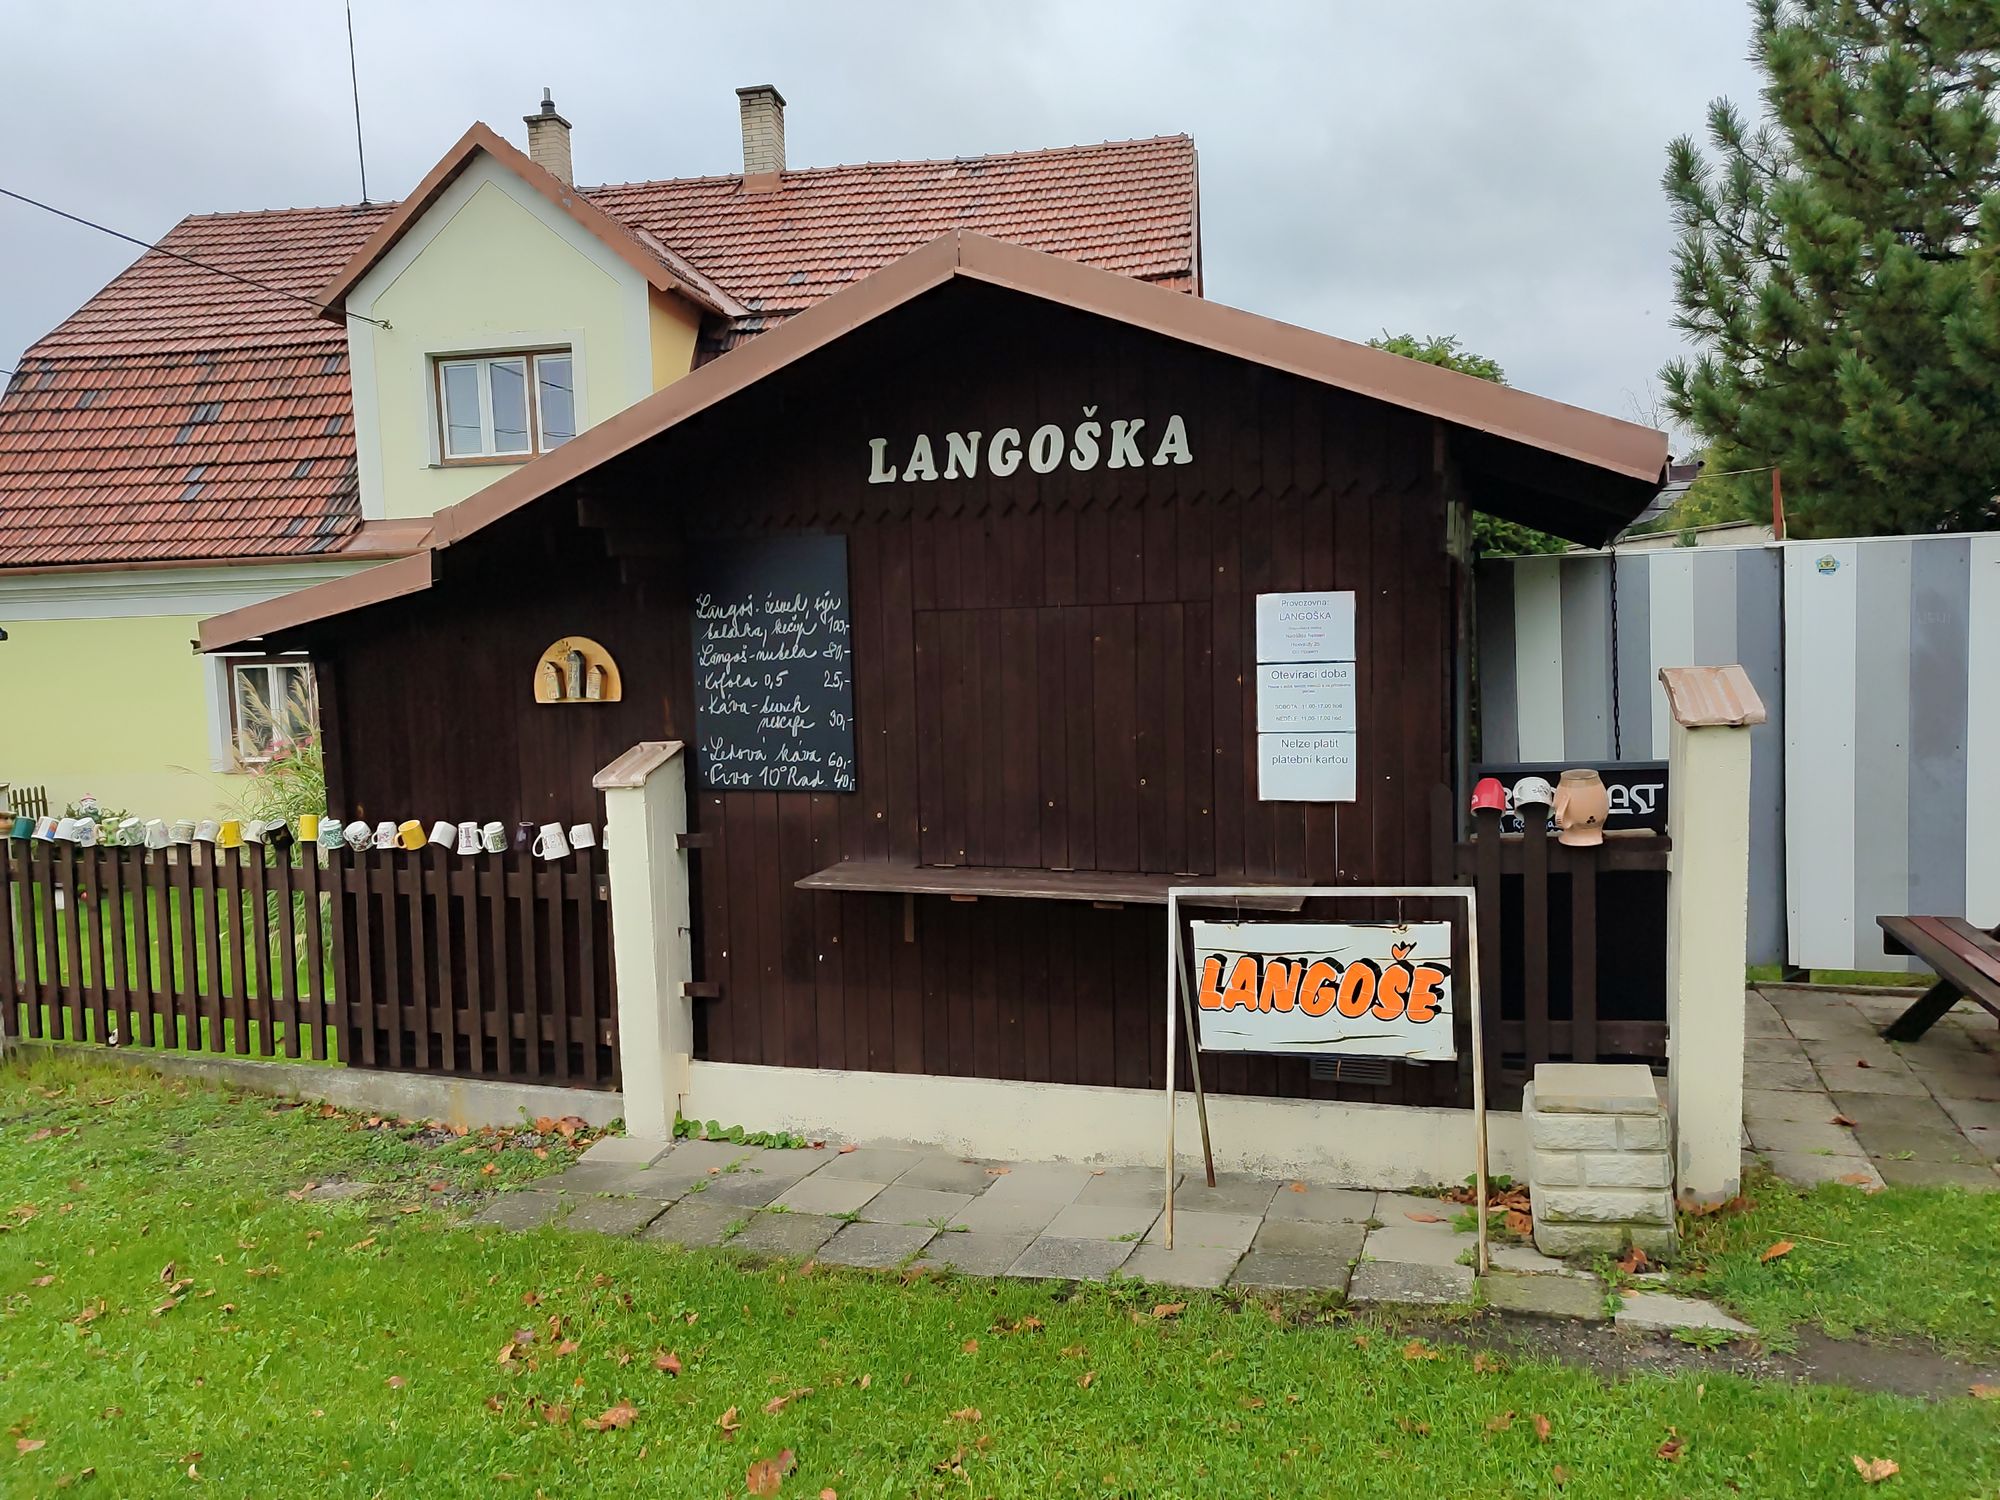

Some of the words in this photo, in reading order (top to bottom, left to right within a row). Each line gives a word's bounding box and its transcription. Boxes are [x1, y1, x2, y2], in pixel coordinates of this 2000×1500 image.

[867, 405, 1194, 485] LANGOŠKA
[813, 590, 842, 625] sýr
[1281, 599, 1329, 607] Provozovna:
[827, 615, 850, 636] 100,-
[1279, 610, 1332, 621] LANGOŠKA
[704, 672, 759, 699] Kofola
[764, 669, 789, 690] 0,5
[823, 670, 851, 691] 25,-
[1320, 668, 1347, 679] doba
[829, 709, 854, 731] 30,-
[774, 739, 822, 763] káva
[1281, 739, 1311, 749] Nelze
[1313, 738, 1339, 750] platit
[1272, 754, 1313, 765] platební
[1315, 754, 1349, 764] kartou
[709, 763, 754, 785] Pivo
[1198, 941, 1452, 1024] LANGOŠE
